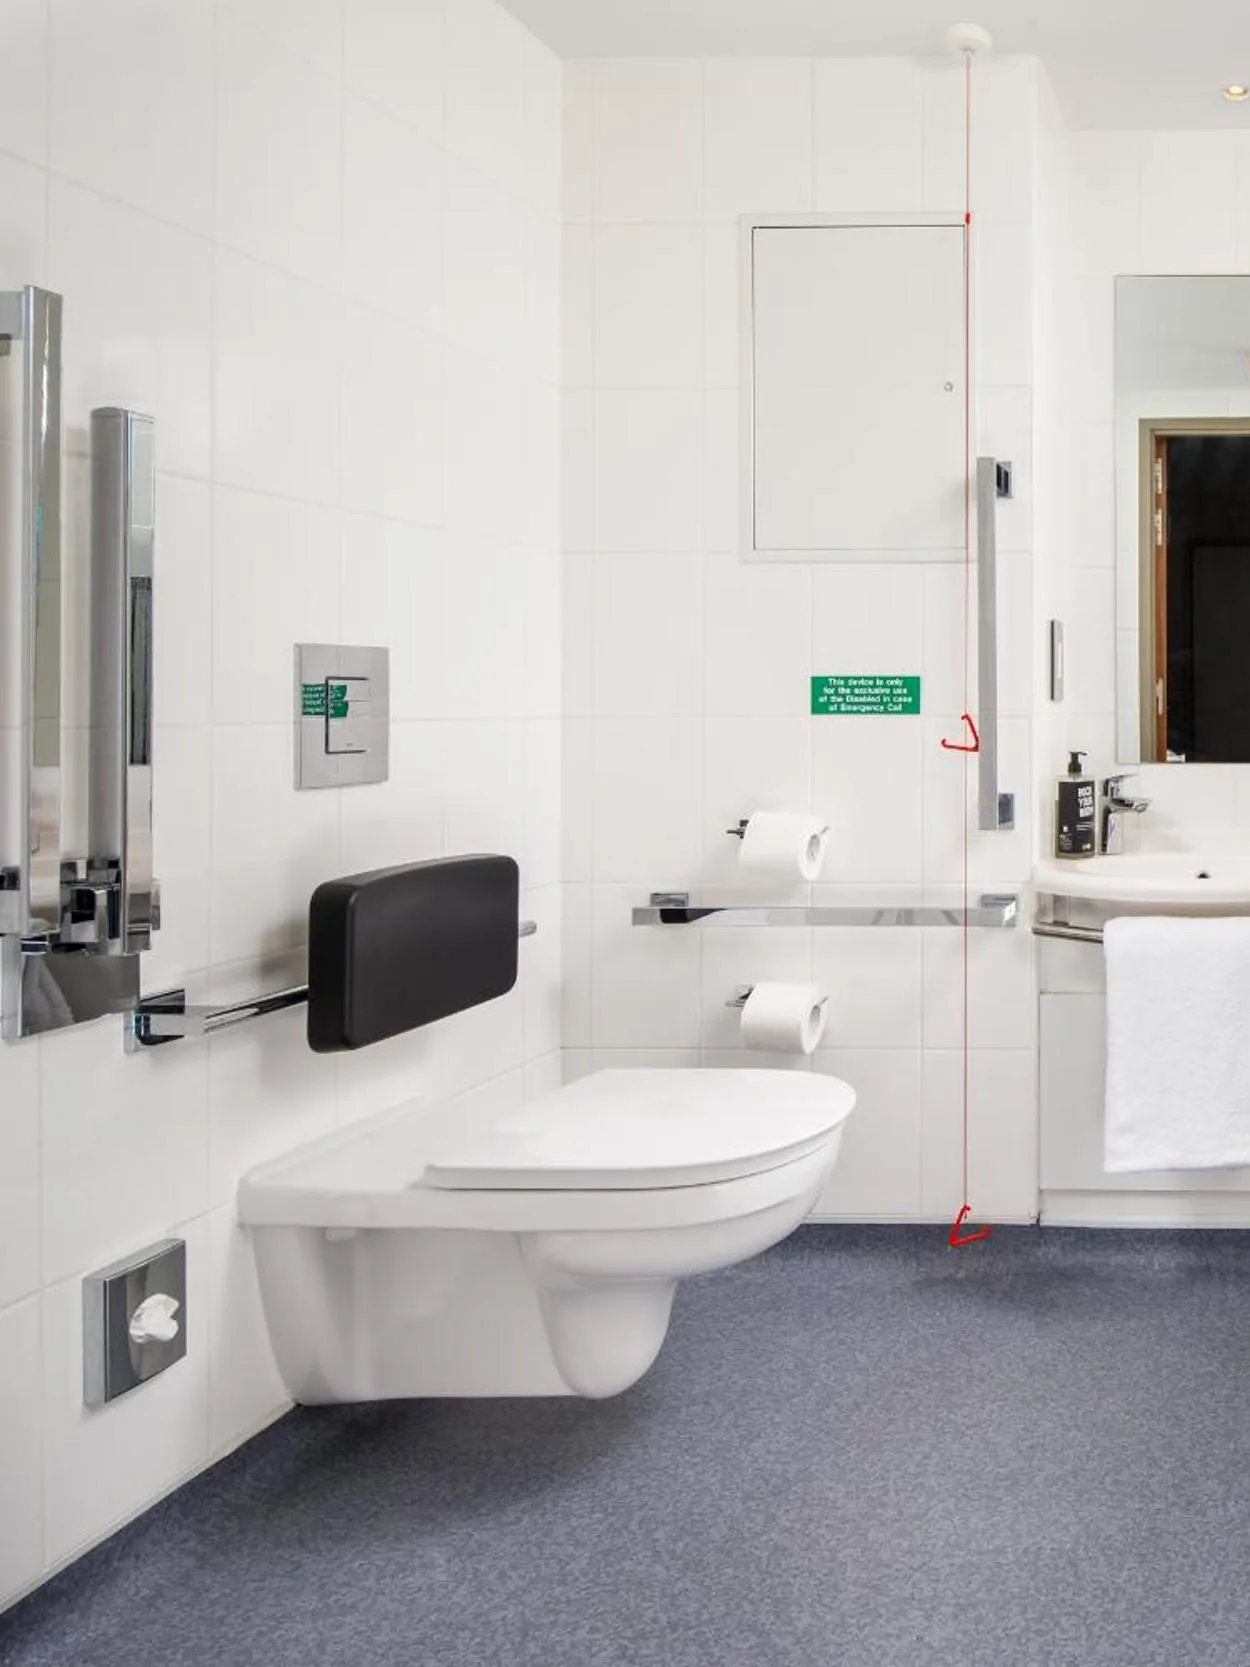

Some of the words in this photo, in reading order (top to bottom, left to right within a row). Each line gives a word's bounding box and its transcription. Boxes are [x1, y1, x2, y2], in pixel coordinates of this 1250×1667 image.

[828, 678, 844, 686] This
[848, 678, 873, 686] device
[876, 678, 883, 686] is
[886, 678, 903, 687] only
[840, 704, 884, 712] Emergency
